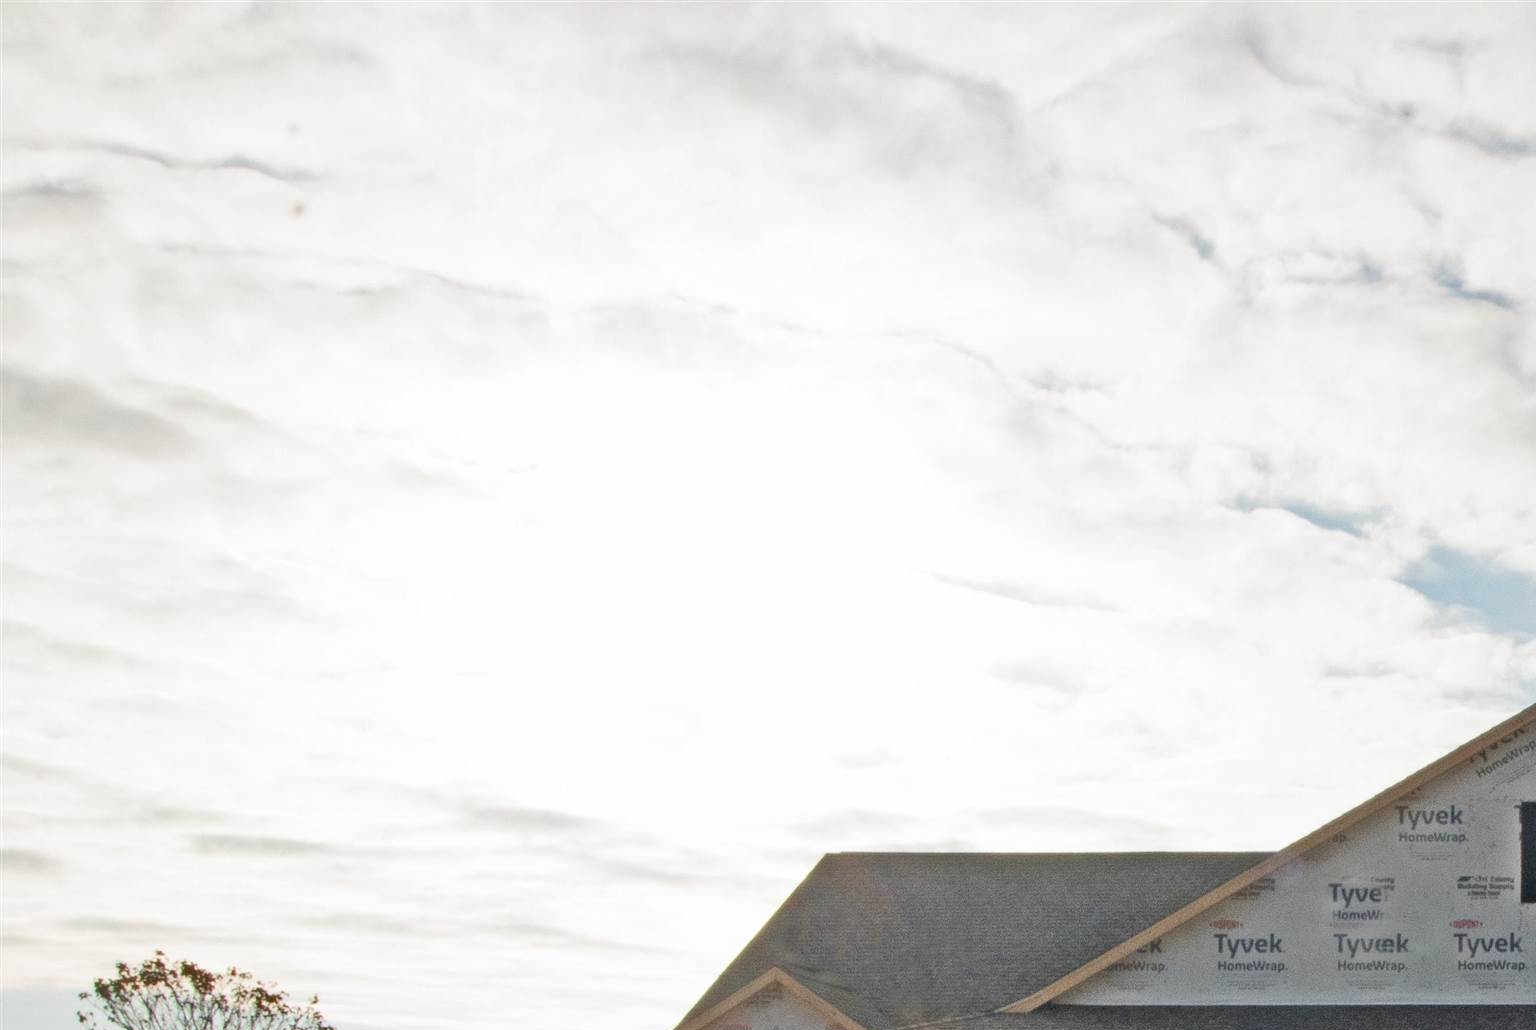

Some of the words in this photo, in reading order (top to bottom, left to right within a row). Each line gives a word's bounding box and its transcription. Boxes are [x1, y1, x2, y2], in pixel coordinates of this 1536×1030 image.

[1475, 740, 1536, 779] HomeWrap
[1395, 805, 1463, 830] Tyvek
[1398, 832, 1467, 845] HomeWrap
[1214, 933, 1282, 958] Tyvek
[1453, 932, 1523, 958] Tyvek
[1218, 960, 1285, 973] HomeWrap
[1338, 960, 1406, 973] HomeWrap
[1458, 959, 1525, 973] HomeWrap
